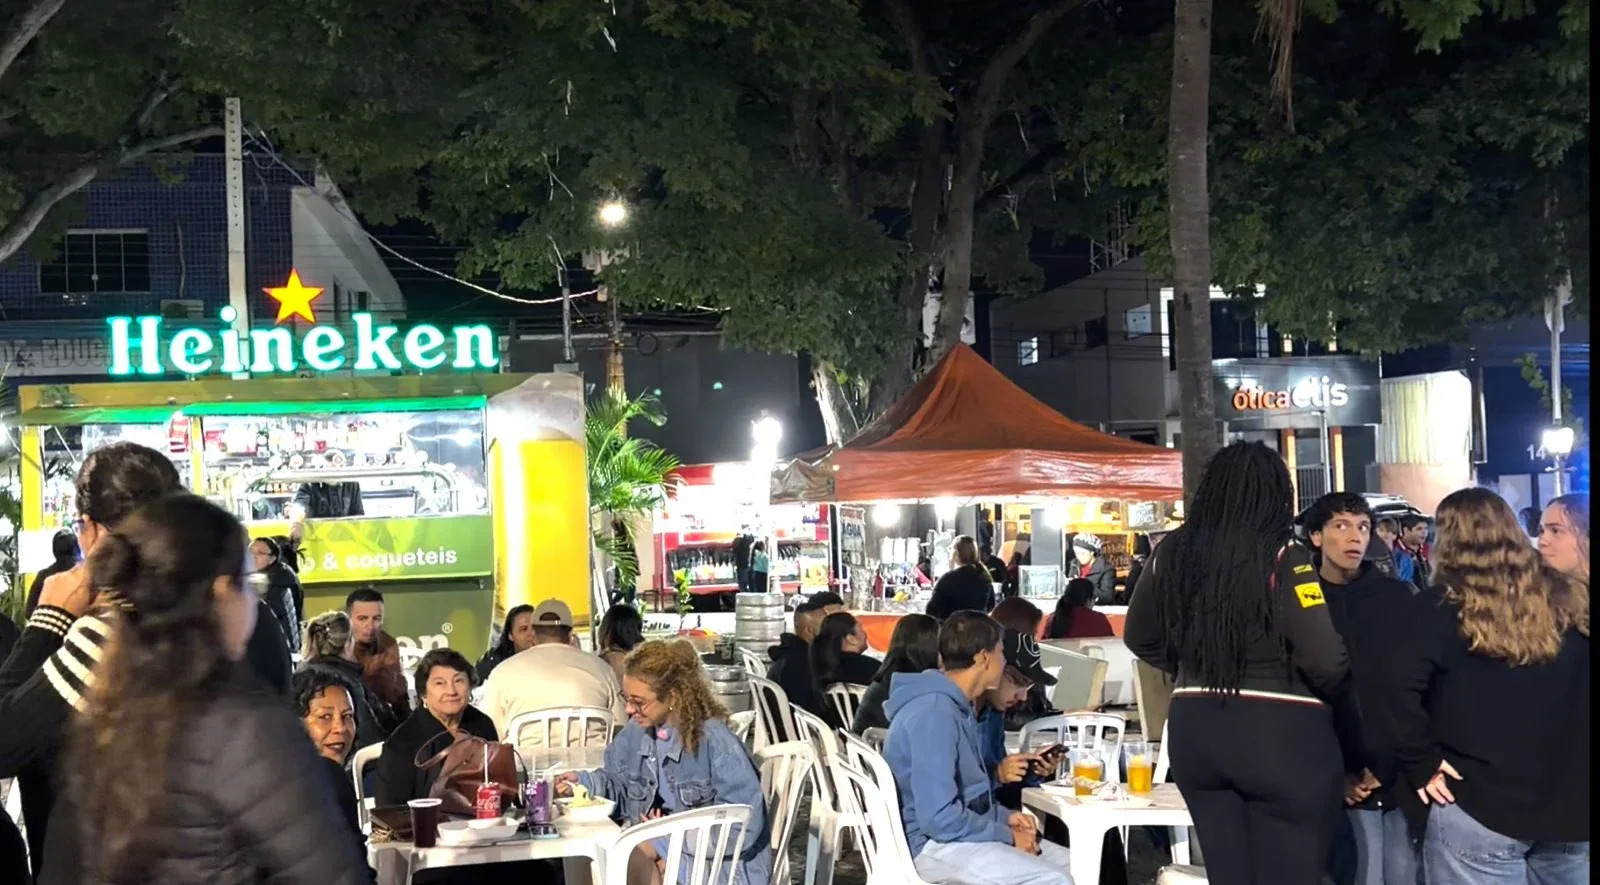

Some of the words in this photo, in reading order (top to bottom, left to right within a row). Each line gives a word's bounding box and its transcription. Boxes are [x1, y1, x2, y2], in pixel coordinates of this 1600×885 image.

[107, 304, 499, 377] Heineken
[322, 551, 338, 571] &
[346, 547, 458, 573] coqueteis
